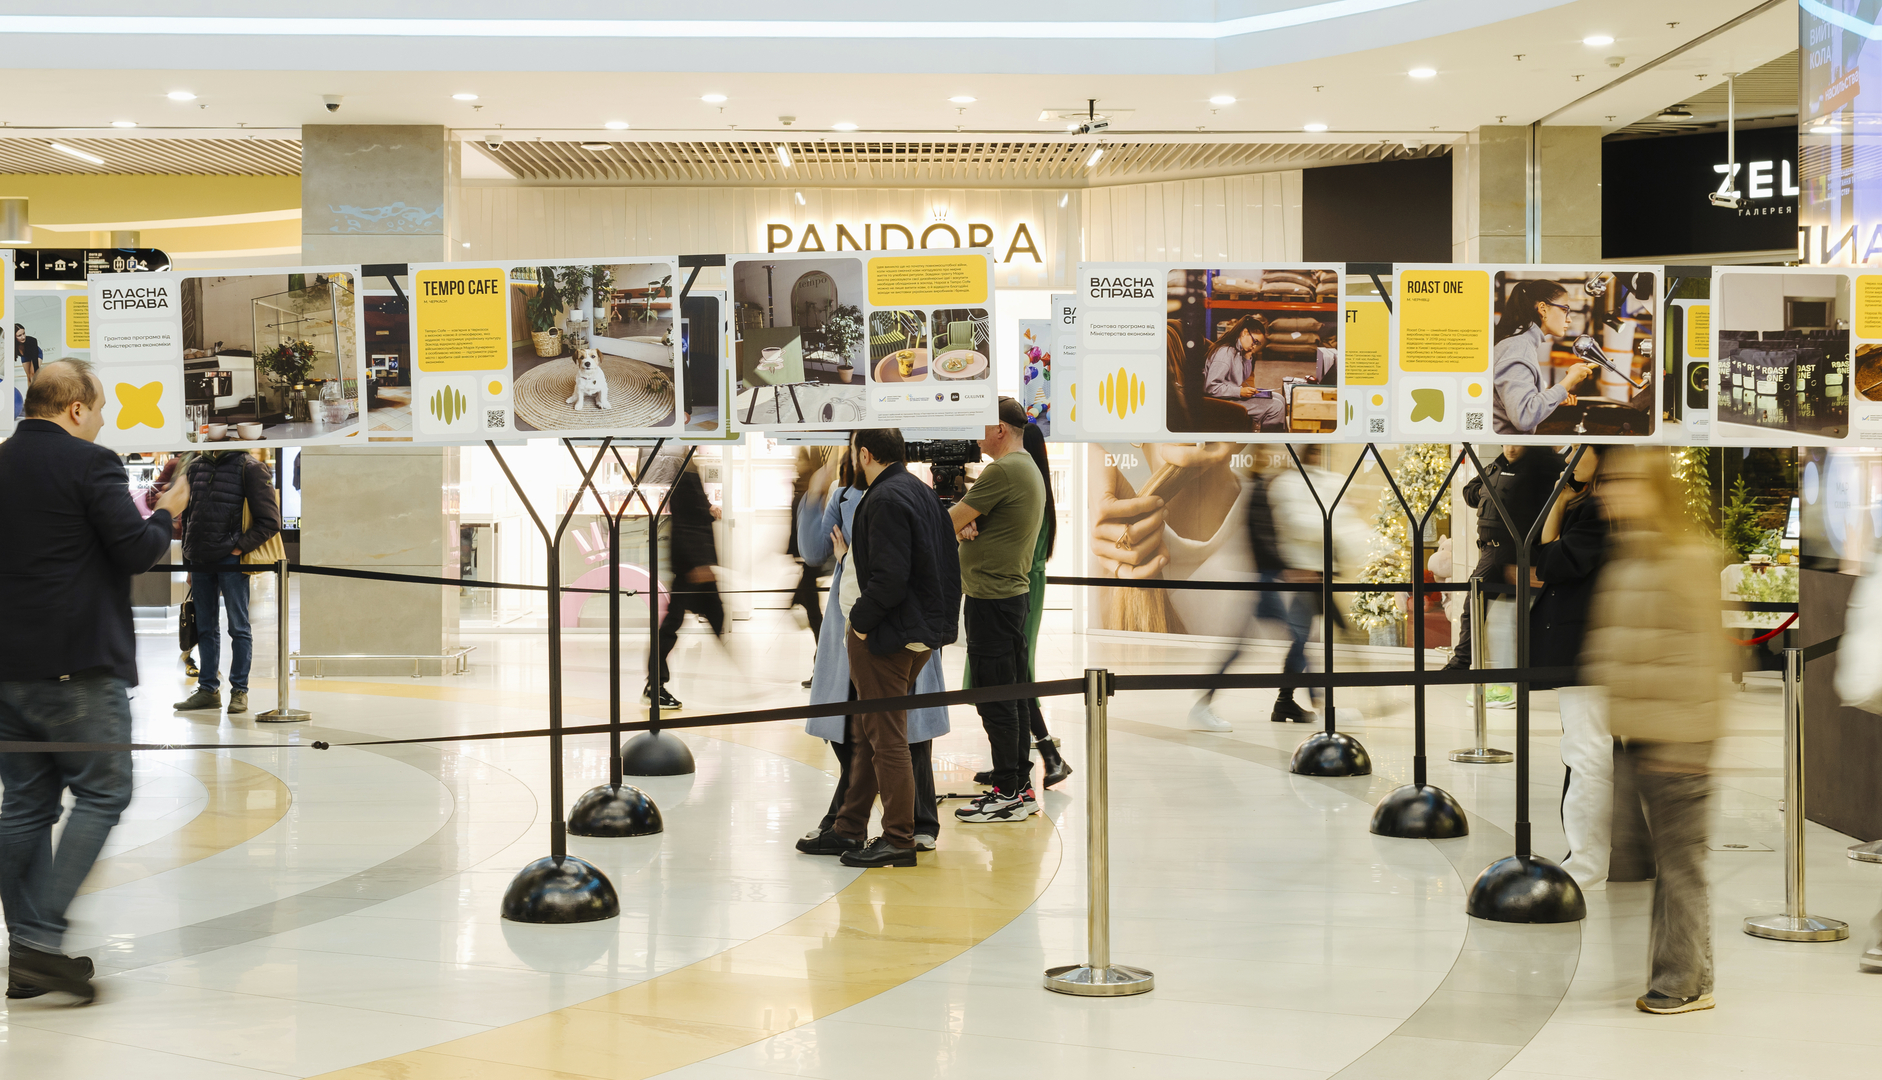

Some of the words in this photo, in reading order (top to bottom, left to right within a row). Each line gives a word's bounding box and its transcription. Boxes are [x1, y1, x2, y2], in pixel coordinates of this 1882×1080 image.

[1810, 46, 1832, 70] КОЛА
[1713, 159, 1799, 198] ZEL
[1738, 206, 1792, 216] ГАЛЕРЕЯ
[766, 223, 1042, 263] PANDORA
[423, 280, 464, 296] TEMPO
[468, 280, 498, 294] CAFE
[799, 278, 827, 288] tempo
[1090, 278, 1154, 287] ВЛАСНА
[1407, 281, 1440, 294] ROAST
[1443, 281, 1463, 294] ONE
[102, 288, 168, 299] ВЛАСНА
[1090, 288, 1154, 298] СПРАВА
[103, 299, 168, 310] СПРАВА
[1104, 454, 1138, 470] БУДЬ
[1836, 482, 1849, 495] MAP
